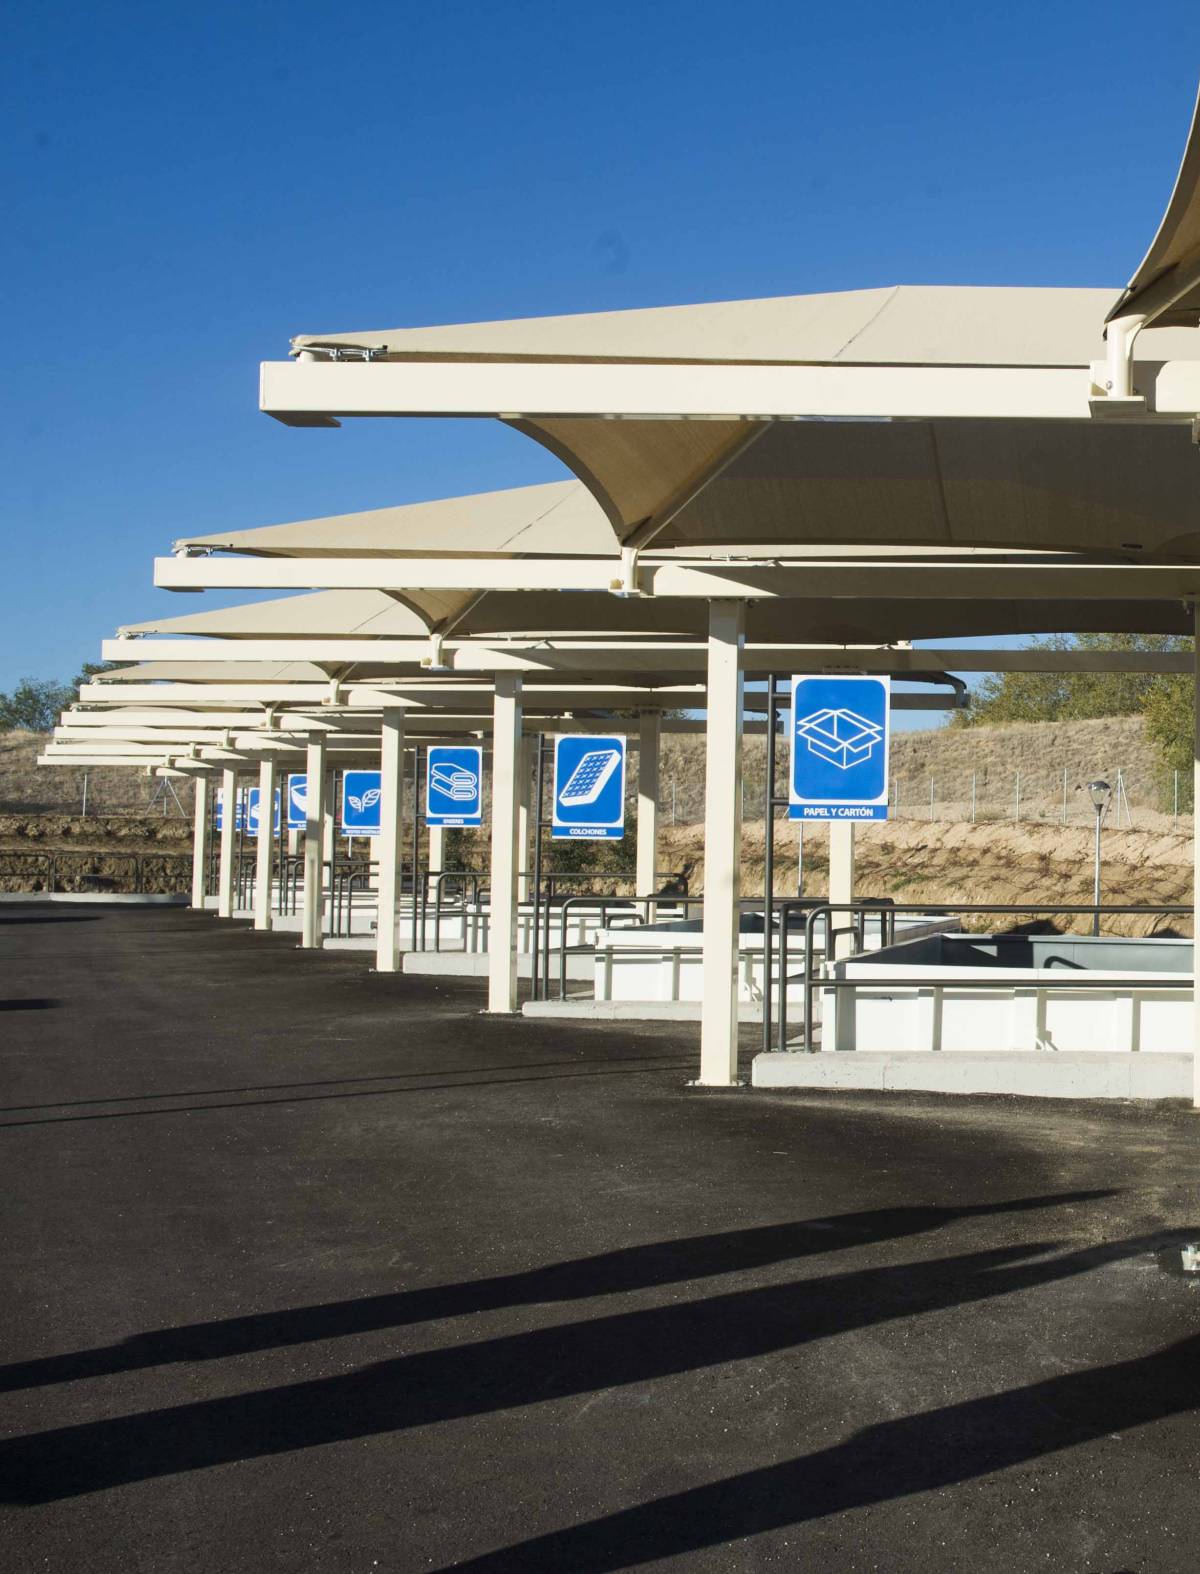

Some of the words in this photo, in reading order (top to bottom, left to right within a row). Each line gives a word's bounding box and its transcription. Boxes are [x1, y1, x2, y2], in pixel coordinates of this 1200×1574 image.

[803, 807, 830, 816] PAPEL
[831, 808, 838, 816] Y
[838, 806, 874, 817] CARTÓN
[569, 828, 607, 836] COLCHONES
